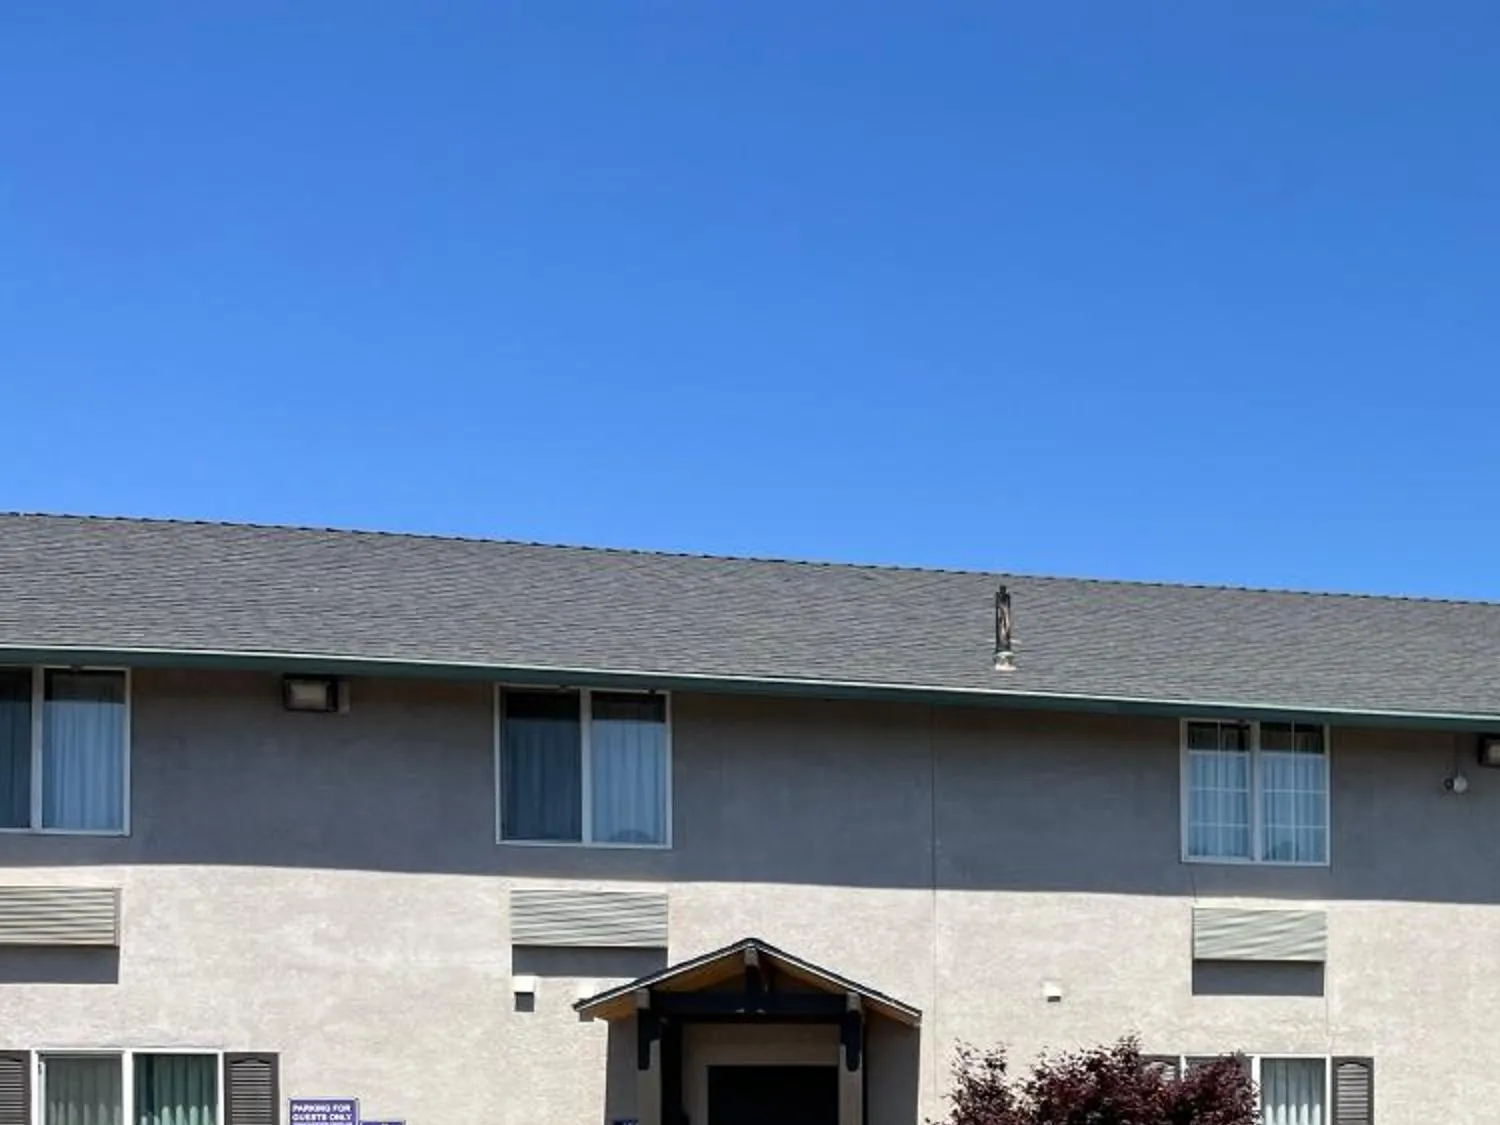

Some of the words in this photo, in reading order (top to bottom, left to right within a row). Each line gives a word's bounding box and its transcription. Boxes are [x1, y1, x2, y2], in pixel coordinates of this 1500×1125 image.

[292, 1103, 330, 1113] PARKING
[332, 1103, 351, 1113] FOR
[291, 1113, 327, 1121] GUESTS
[329, 1113, 353, 1121] ONLY
